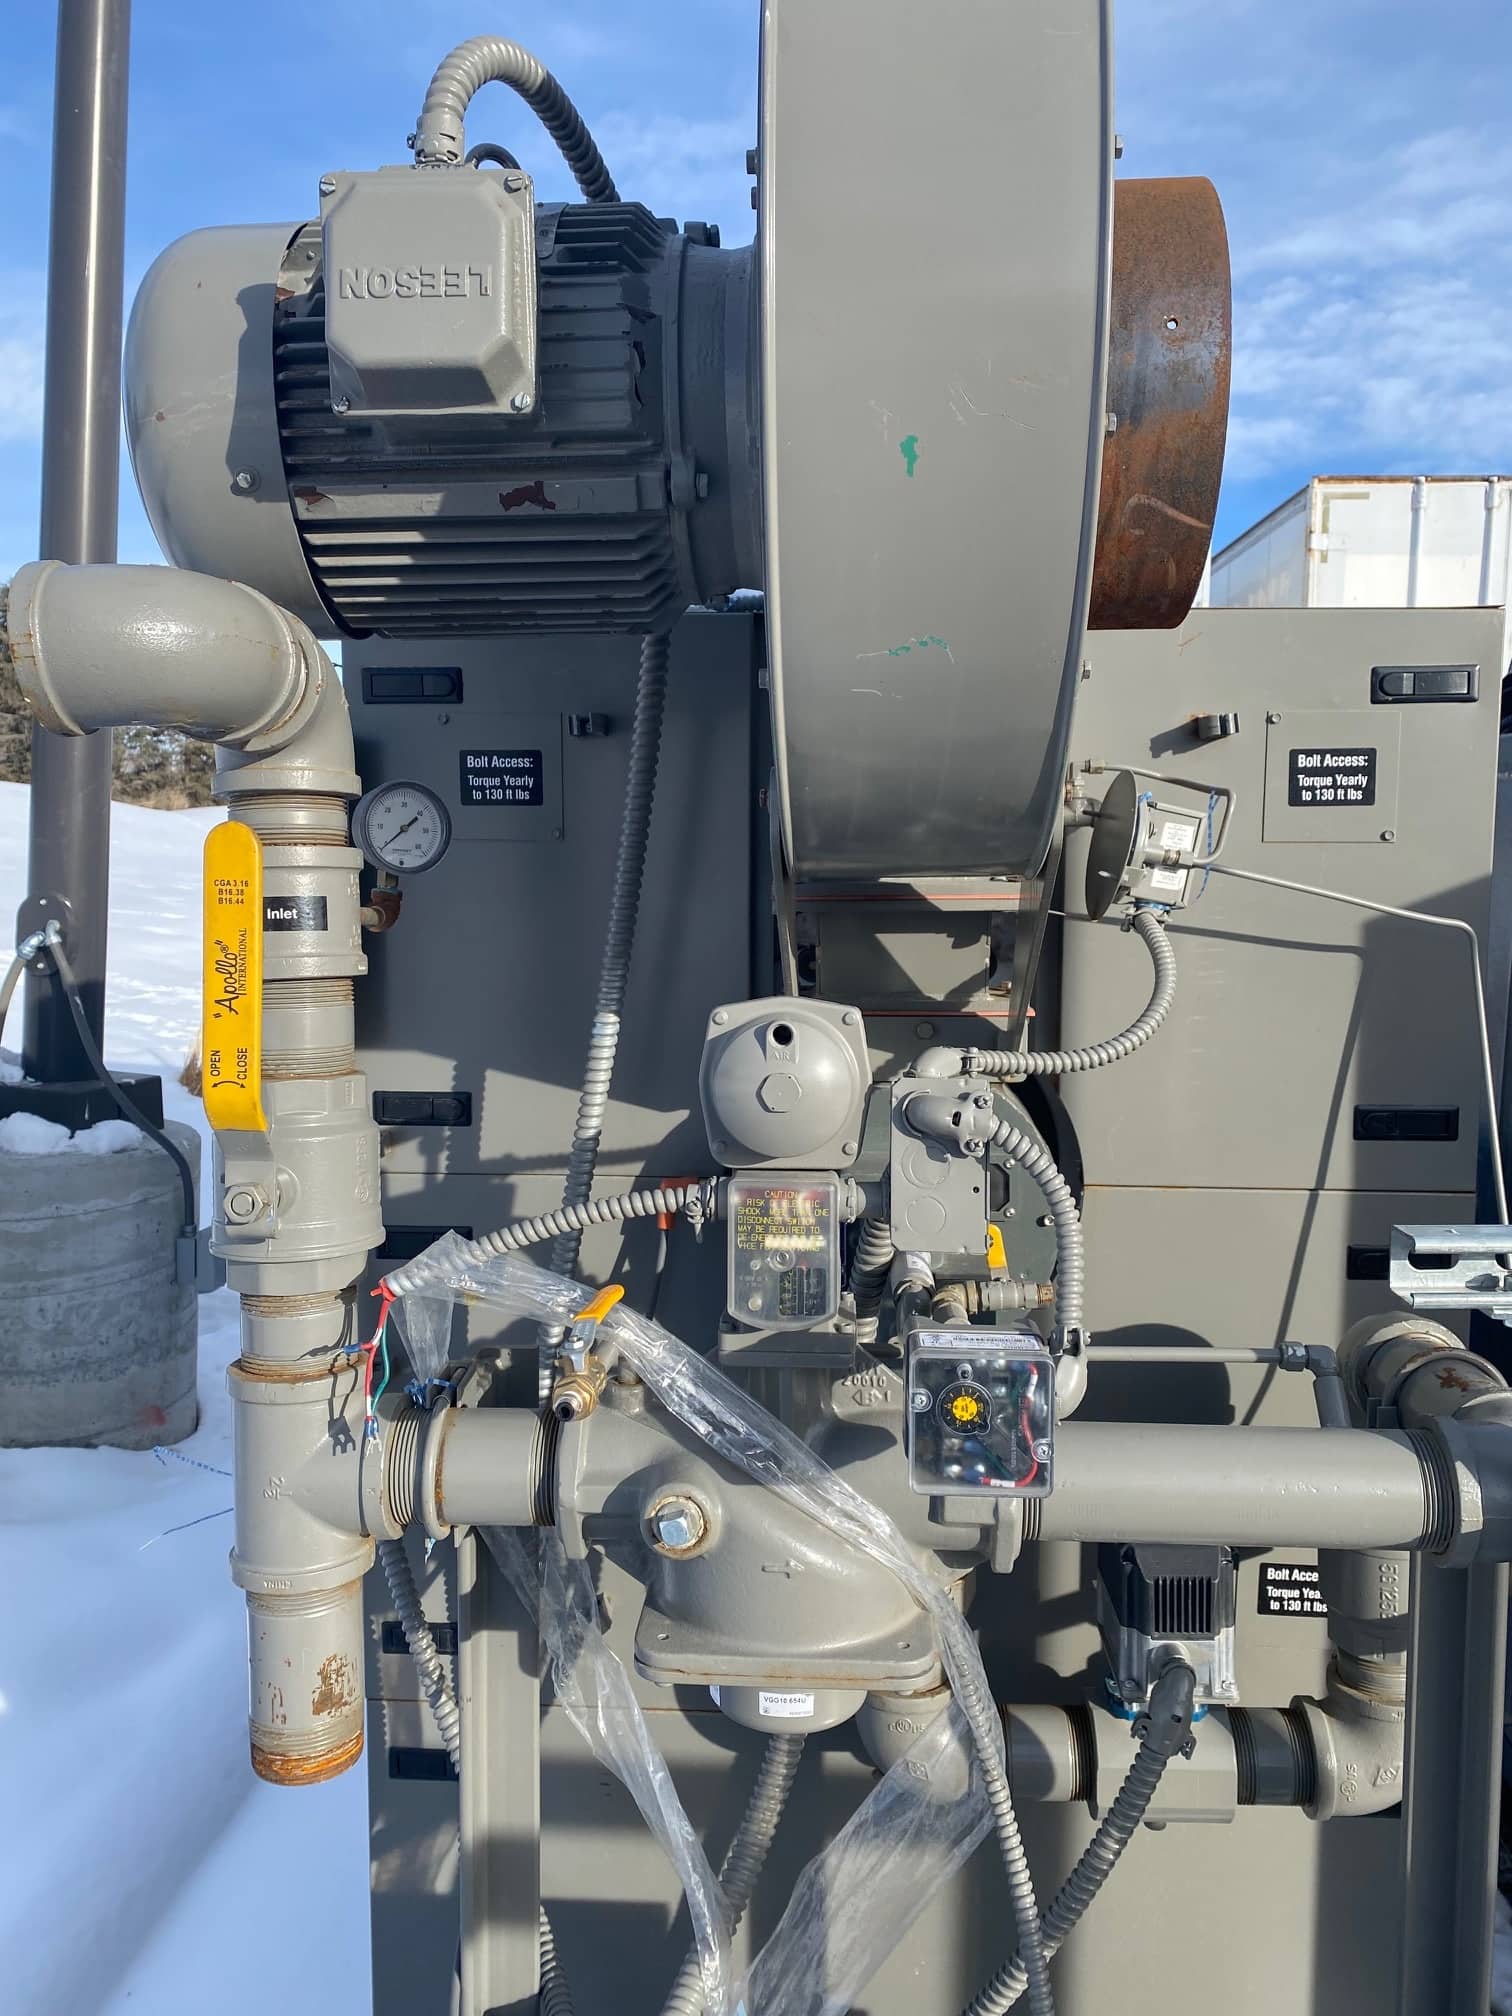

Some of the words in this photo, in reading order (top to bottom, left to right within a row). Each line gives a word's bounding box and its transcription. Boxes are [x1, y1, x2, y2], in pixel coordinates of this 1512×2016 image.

[339, 264, 493, 300] LEESON
[467, 755, 488, 768] Bolt
[491, 755, 534, 768] Access:
[1298, 753, 1321, 768] Bolt
[1323, 753, 1369, 768] Access:
[467, 775, 501, 788] Torque
[503, 775, 534, 789] Yearly
[1297, 774, 1333, 788] Torque
[1335, 773, 1368, 788] Yearly
[473, 789, 482, 800] to
[485, 788, 503, 800] 130
[506, 788, 513, 800] ft
[515, 788, 530, 800] lbs
[1302, 789, 1312, 801] to
[1315, 788, 1335, 800] 130
[1337, 788, 1345, 800] ft
[1347, 788, 1363, 800] lbs
[214, 879, 232, 887] CGA
[233, 880, 249, 888] 3.16
[218, 897, 245, 905] B16.44
[267, 908, 298, 920] Inlet
[237, 927, 247, 992] INTERNATIONAL
[210, 1050, 221, 1077] OPEN
[237, 1047, 248, 1080] CLOSE
[815, 1208, 830, 1217] ONE
[737, 1225, 751, 1233] MAY
[756, 1226, 766, 1234] BE
[769, 1226, 806, 1234] REQUIRED
[811, 1226, 820, 1234] TO
[1267, 1567, 1290, 1581] Bolt
[1266, 1585, 1301, 1600] Torque
[1270, 1599, 1280, 1610] to
[1282, 1599, 1301, 1611] 130
[1303, 1600, 1311, 1612] ft
[1313, 1600, 1328, 1613] lbs
